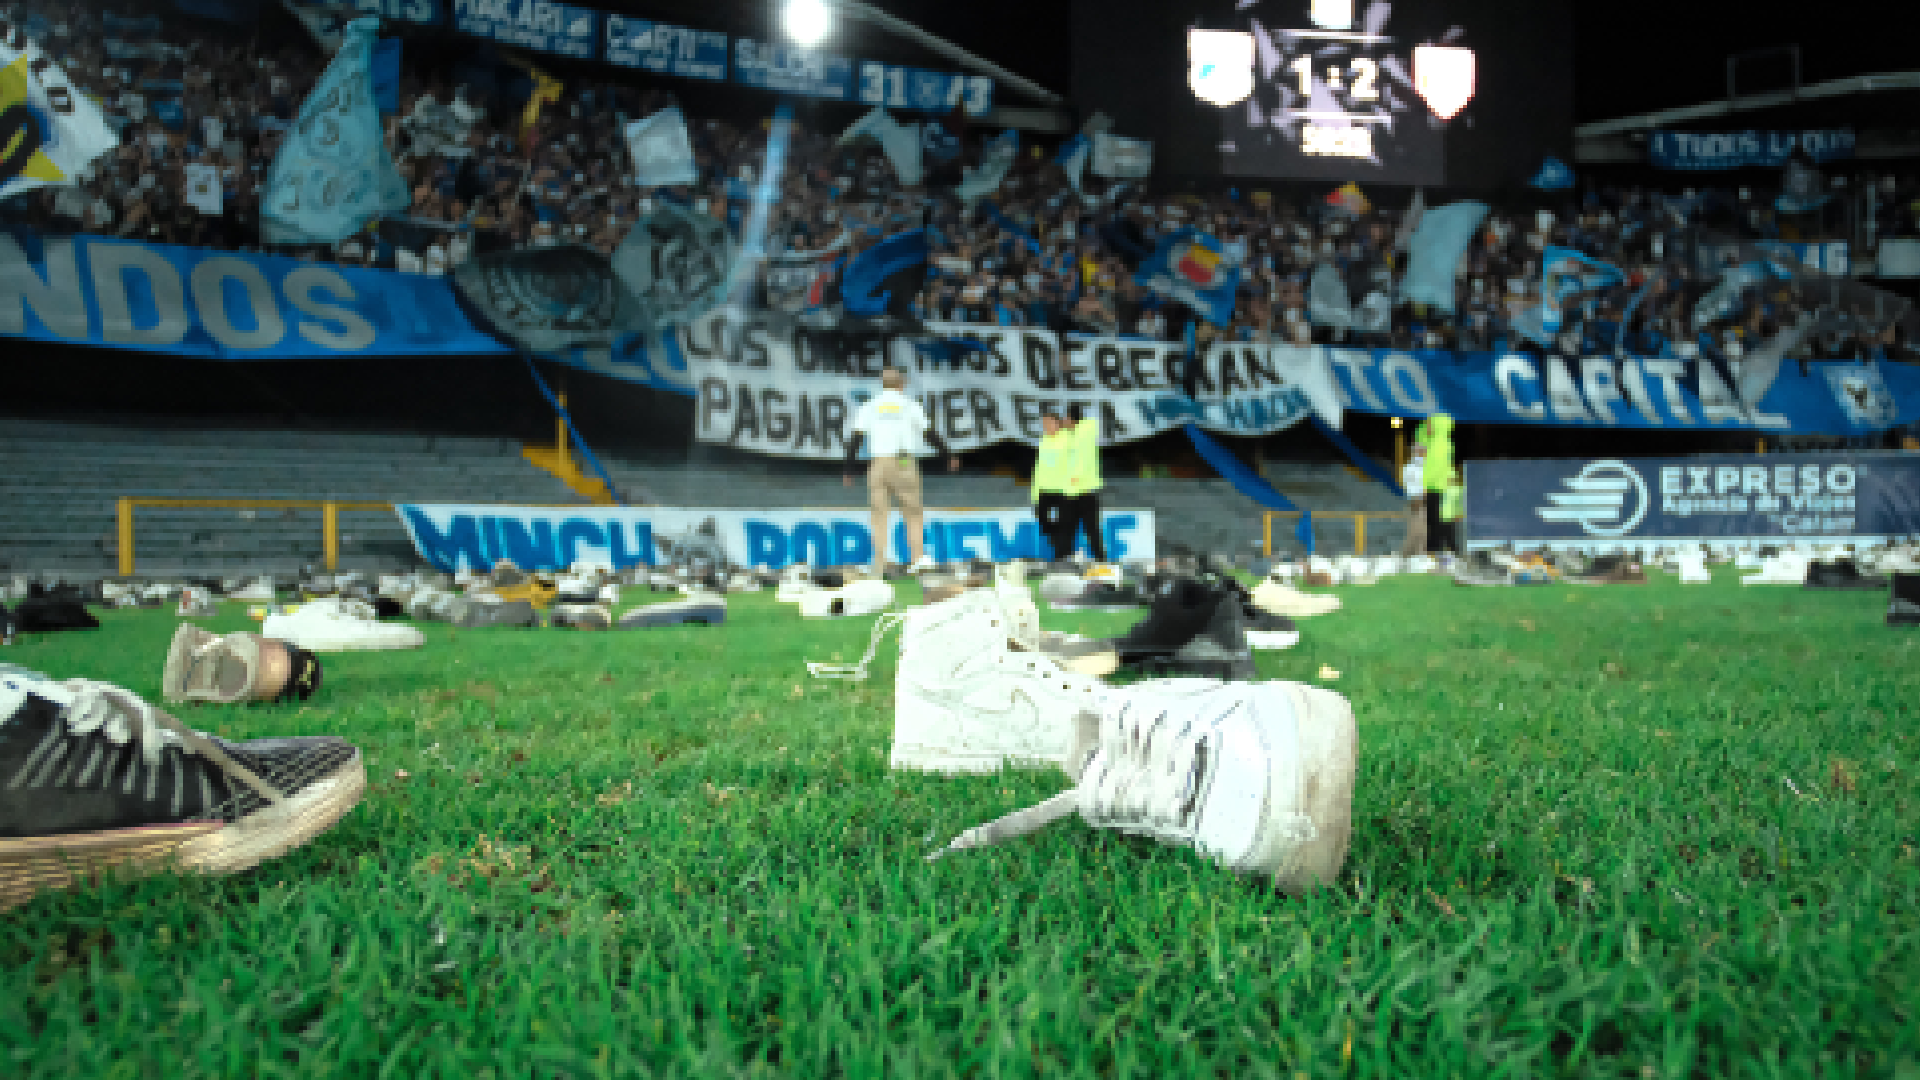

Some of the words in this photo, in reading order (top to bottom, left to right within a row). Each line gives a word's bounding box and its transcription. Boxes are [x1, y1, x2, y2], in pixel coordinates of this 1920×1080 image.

[1292, 56, 1311, 98] 1
[1350, 58, 1379, 101] 2
[1660, 464, 1856, 495] EXPRESO
